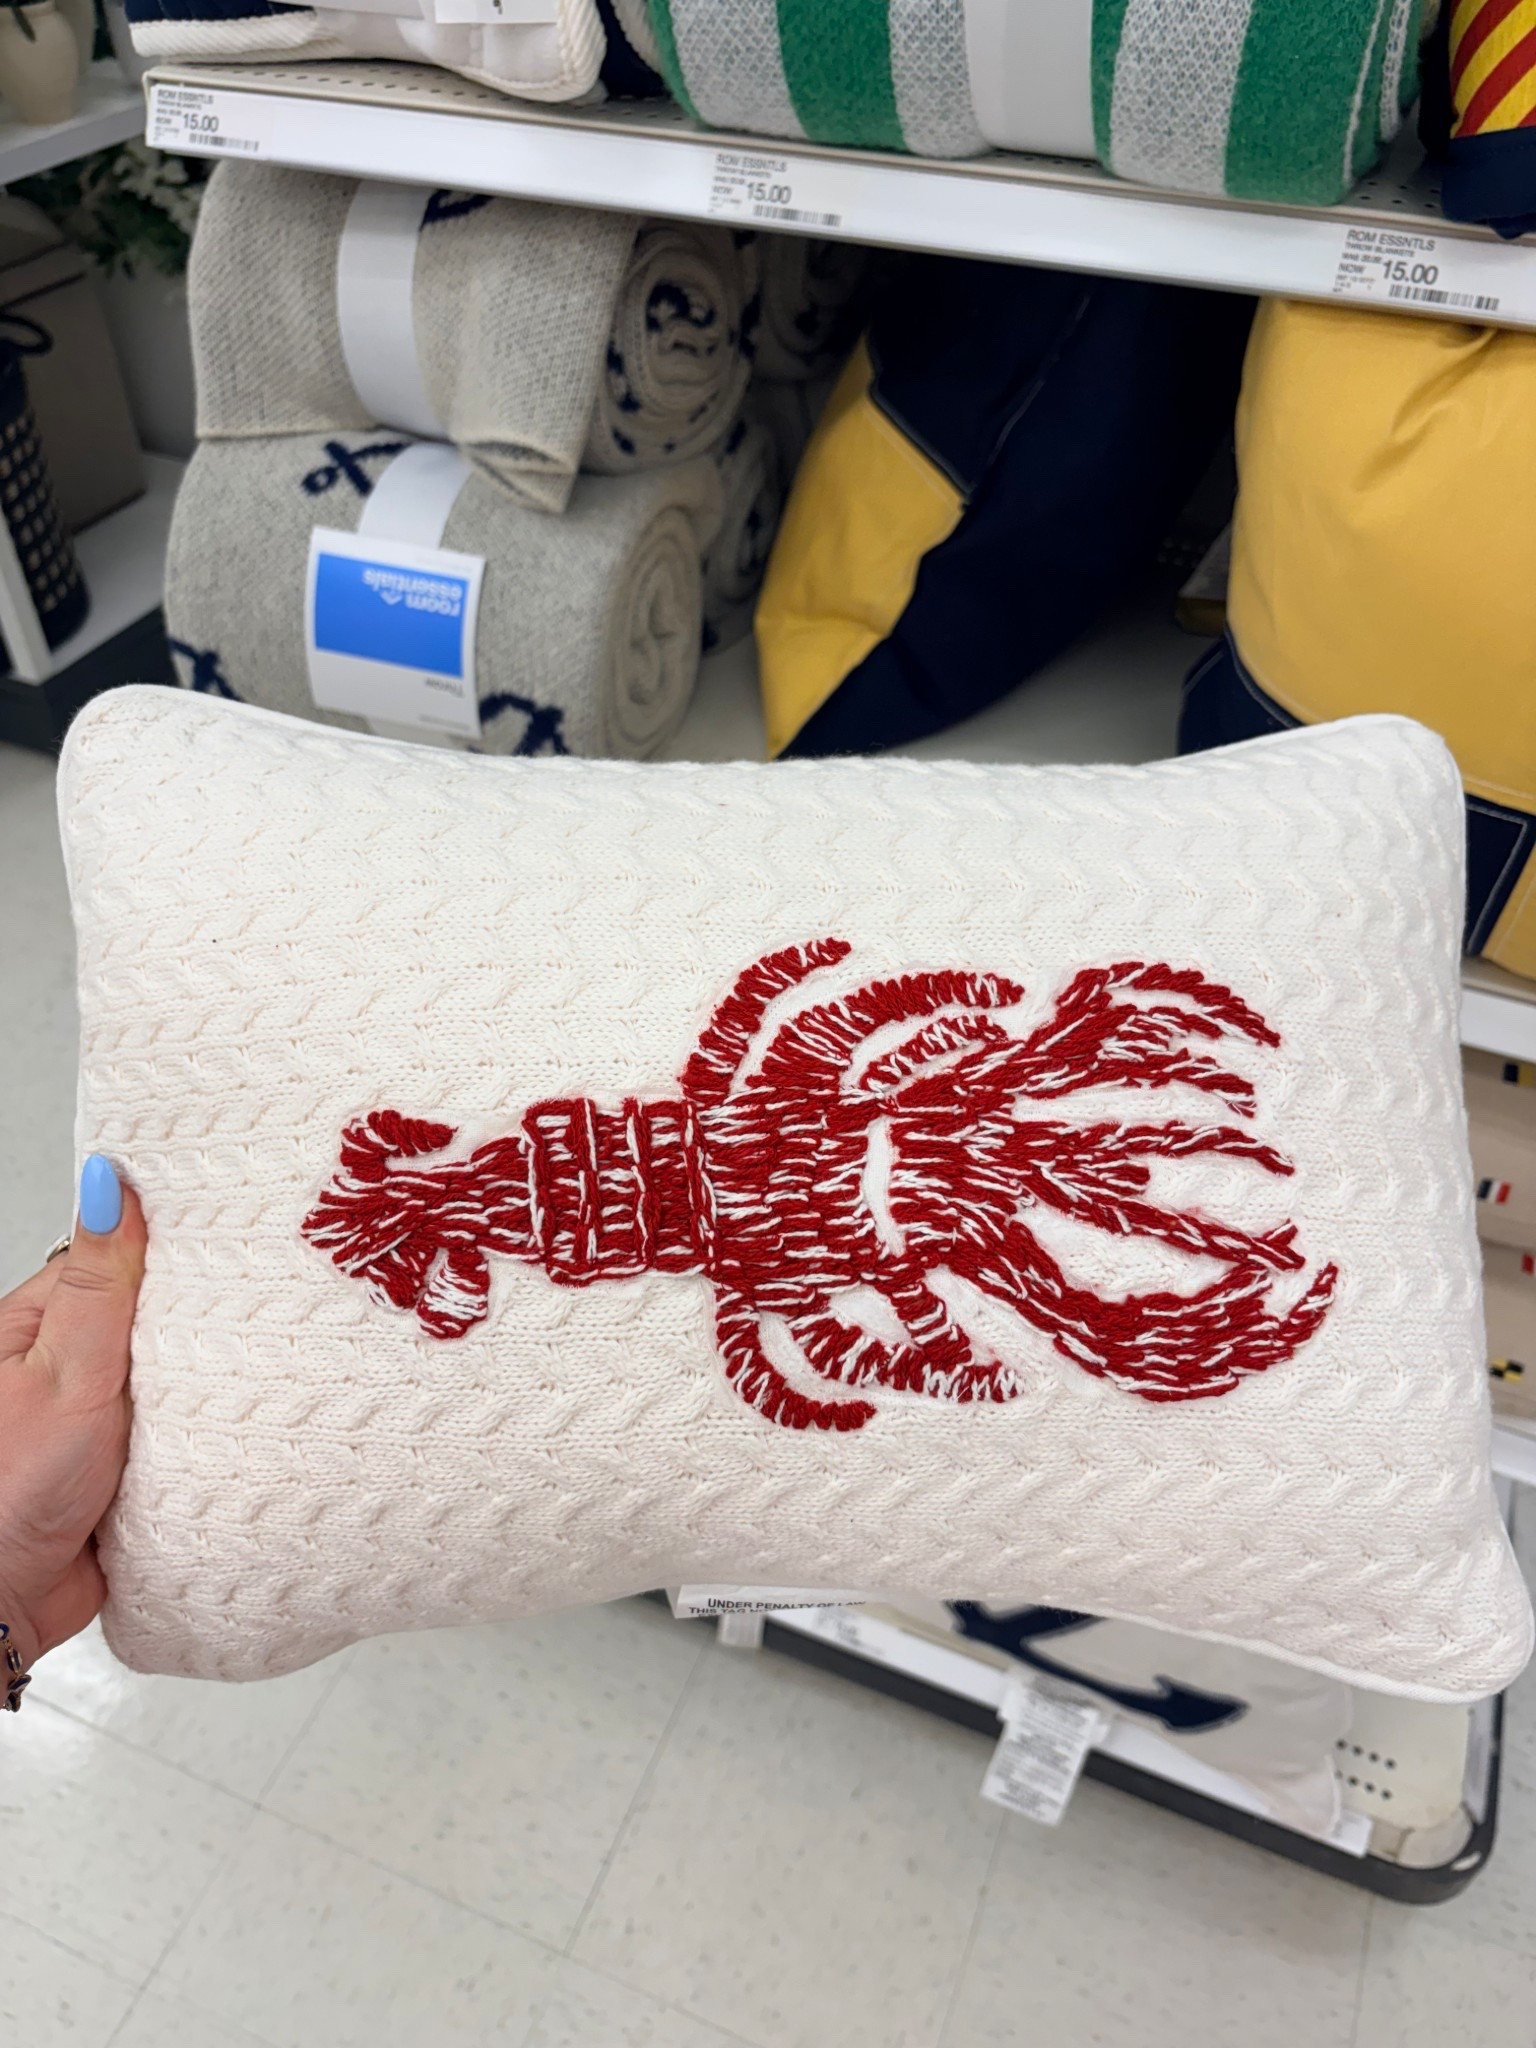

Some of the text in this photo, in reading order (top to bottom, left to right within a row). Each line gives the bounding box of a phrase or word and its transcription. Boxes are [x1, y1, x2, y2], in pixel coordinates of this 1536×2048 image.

[183, 113, 219, 132] 15.00
[747, 182, 792, 205] 15.00
[1347, 229, 1436, 251] ROM ESSNTLS
[1338, 262, 1367, 274] NOW
[1382, 259, 1439, 285] 15.00
[362, 568, 463, 601] essentials
[405, 594, 461, 617] room
[688, 1606, 717, 1614] THIS
[707, 1598, 753, 1609] UNDER
[755, 1601, 815, 1610] PENALTY
